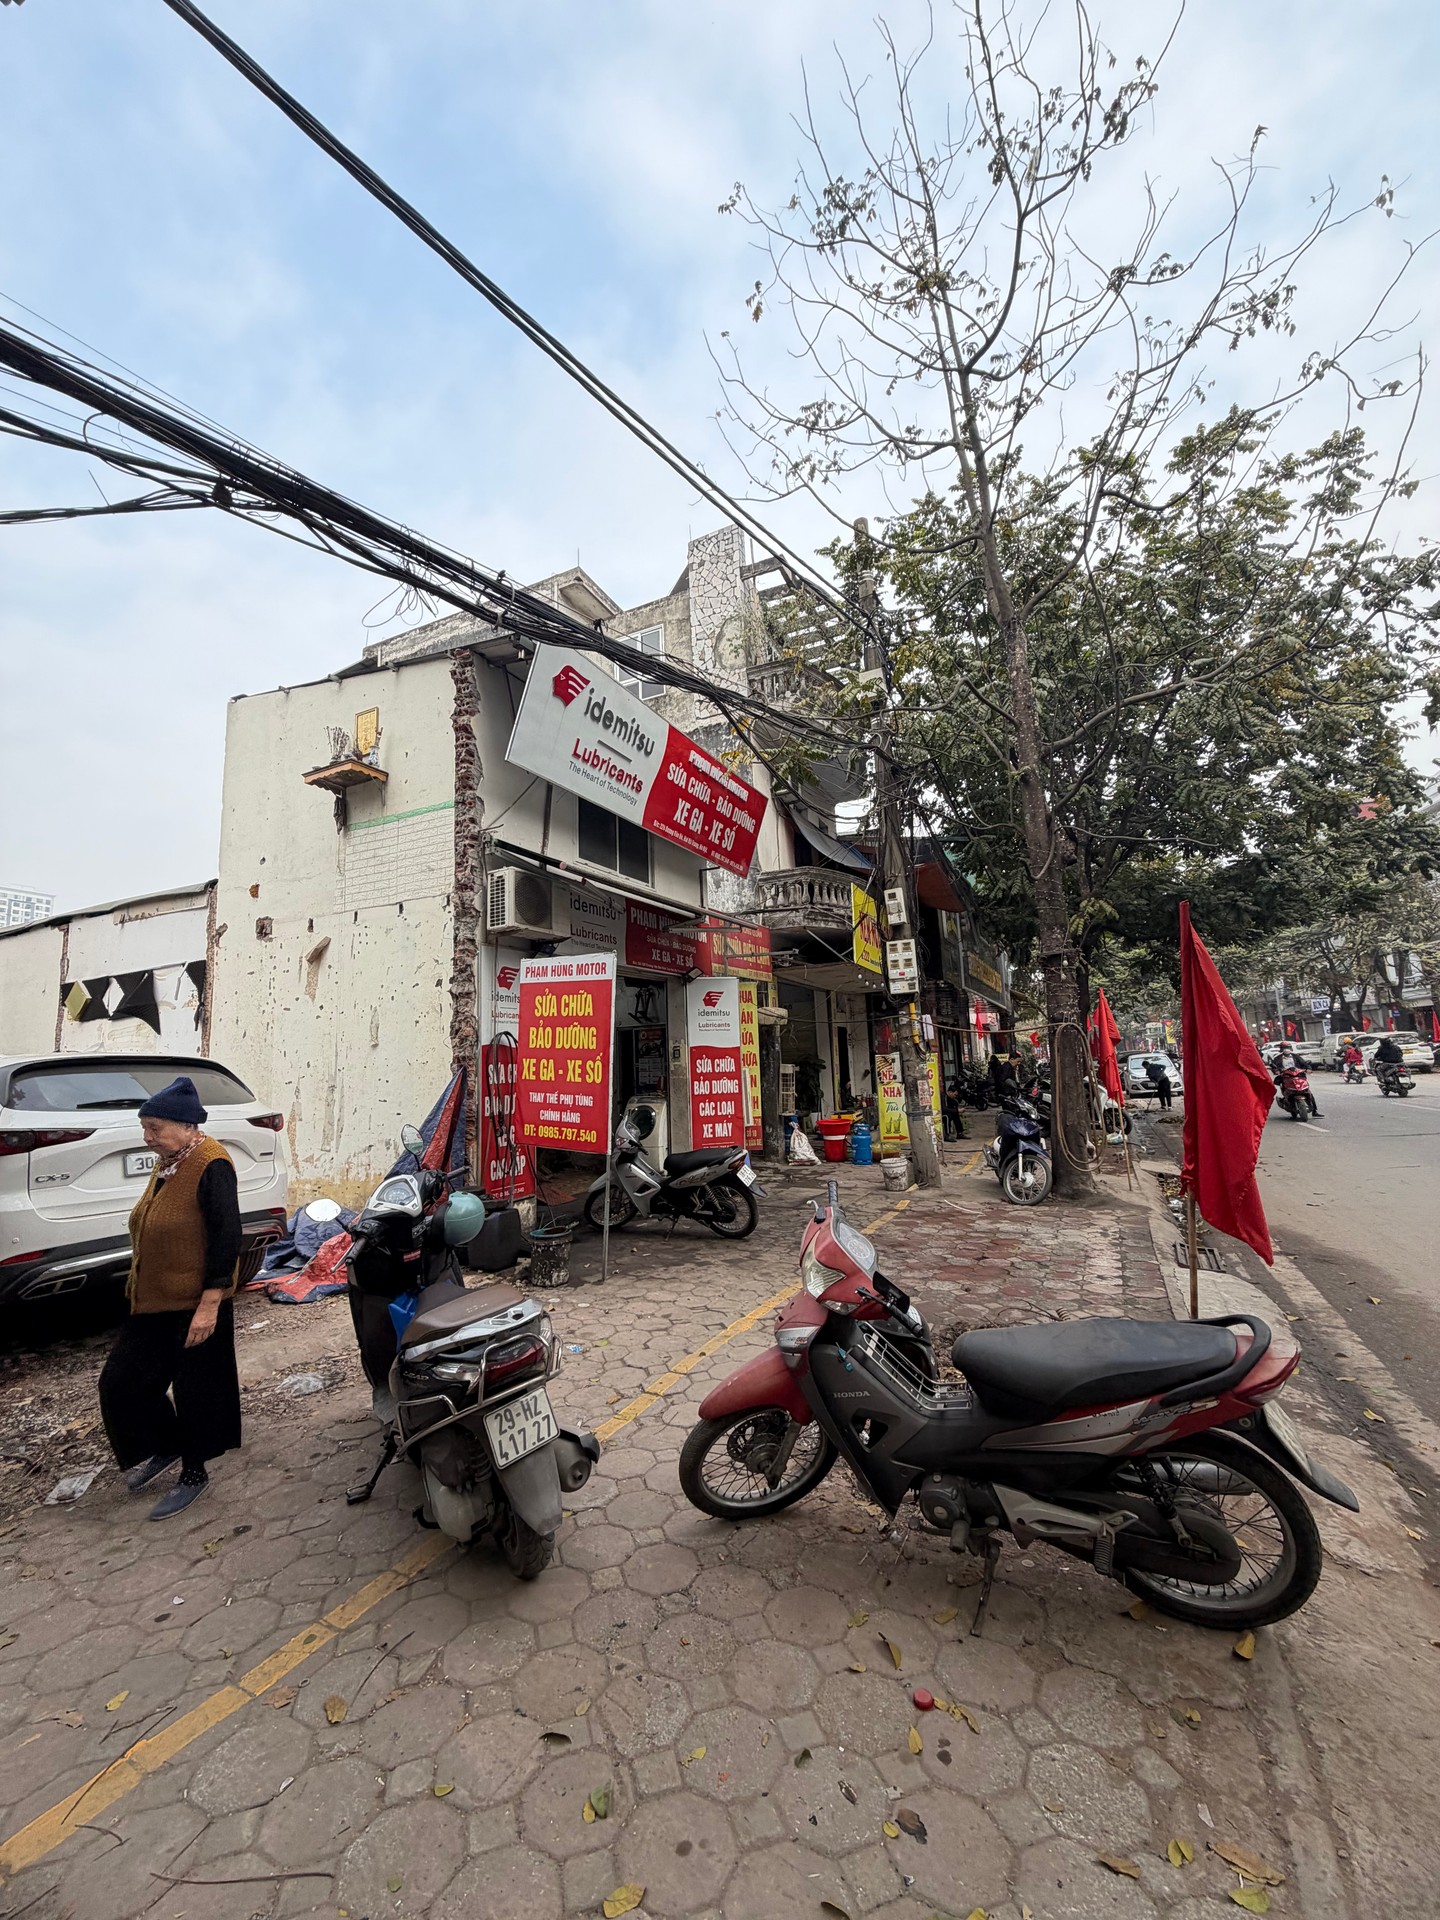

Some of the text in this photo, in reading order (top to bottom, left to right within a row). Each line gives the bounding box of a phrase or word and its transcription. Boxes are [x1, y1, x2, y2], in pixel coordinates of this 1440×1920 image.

[584, 687, 655, 757] idemitsu
[571, 738, 644, 794] Lubricants
[569, 760, 582, 774] The
[581, 767, 600, 785] Heart
[606, 781, 638, 806] Technology
[667, 762, 687, 789] SỬA
[687, 777, 711, 805] CHỮA
[716, 796, 733, 818] BẢO
[732, 807, 756, 834] DƯỠNG
[673, 798, 691, 826] XE
[689, 808, 704, 835] GA
[708, 819, 724, 845] XE
[722, 825, 738, 852] SỐ
[570, 893, 617, 920] idemitsu
[630, 906, 657, 931] PHẠM
[570, 923, 618, 945] Lubricants
[651, 948, 660, 961] XE
[661, 950, 671, 963] GA
[676, 953, 685, 966] XE
[685, 954, 694, 968] SỐ
[525, 962, 607, 981] PHẠM HÙNG MOTOR
[491, 990, 520, 1003] idemits
[534, 988, 593, 1017] SỬA CHỮA
[697, 1008, 731, 1017] idemitsu
[741, 1008, 753, 1025] ÁN
[528, 1019, 597, 1050] BẢO DƯỠNG
[742, 1027, 754, 1046] ỬA
[521, 1058, 537, 1080] XE
[539, 1058, 555, 1081] GA
[566, 1059, 582, 1082] XE
[585, 1052, 603, 1084] SỐ
[696, 1054, 736, 1073] SỬA CHỮA
[694, 1076, 710, 1095] BẢO
[712, 1076, 739, 1094] DƯỠNG
[883, 1086, 902, 1098] NHA
[529, 1092, 545, 1103] THAY
[546, 1090, 559, 1105] THẾ
[559, 1094, 573, 1107] PHỤ
[575, 1092, 593, 1107] TÙNG
[539, 1108, 560, 1122] CHÍNH
[699, 1099, 715, 1117] CÁC
[717, 1101, 735, 1118] LOẠI
[524, 1124, 597, 1143] ĐT: 0985.797.540
[702, 1119, 732, 1138] XE MÁY
[35, 1173, 70, 1183] CX-5
[498, 1414, 552, 1461] 417.27
